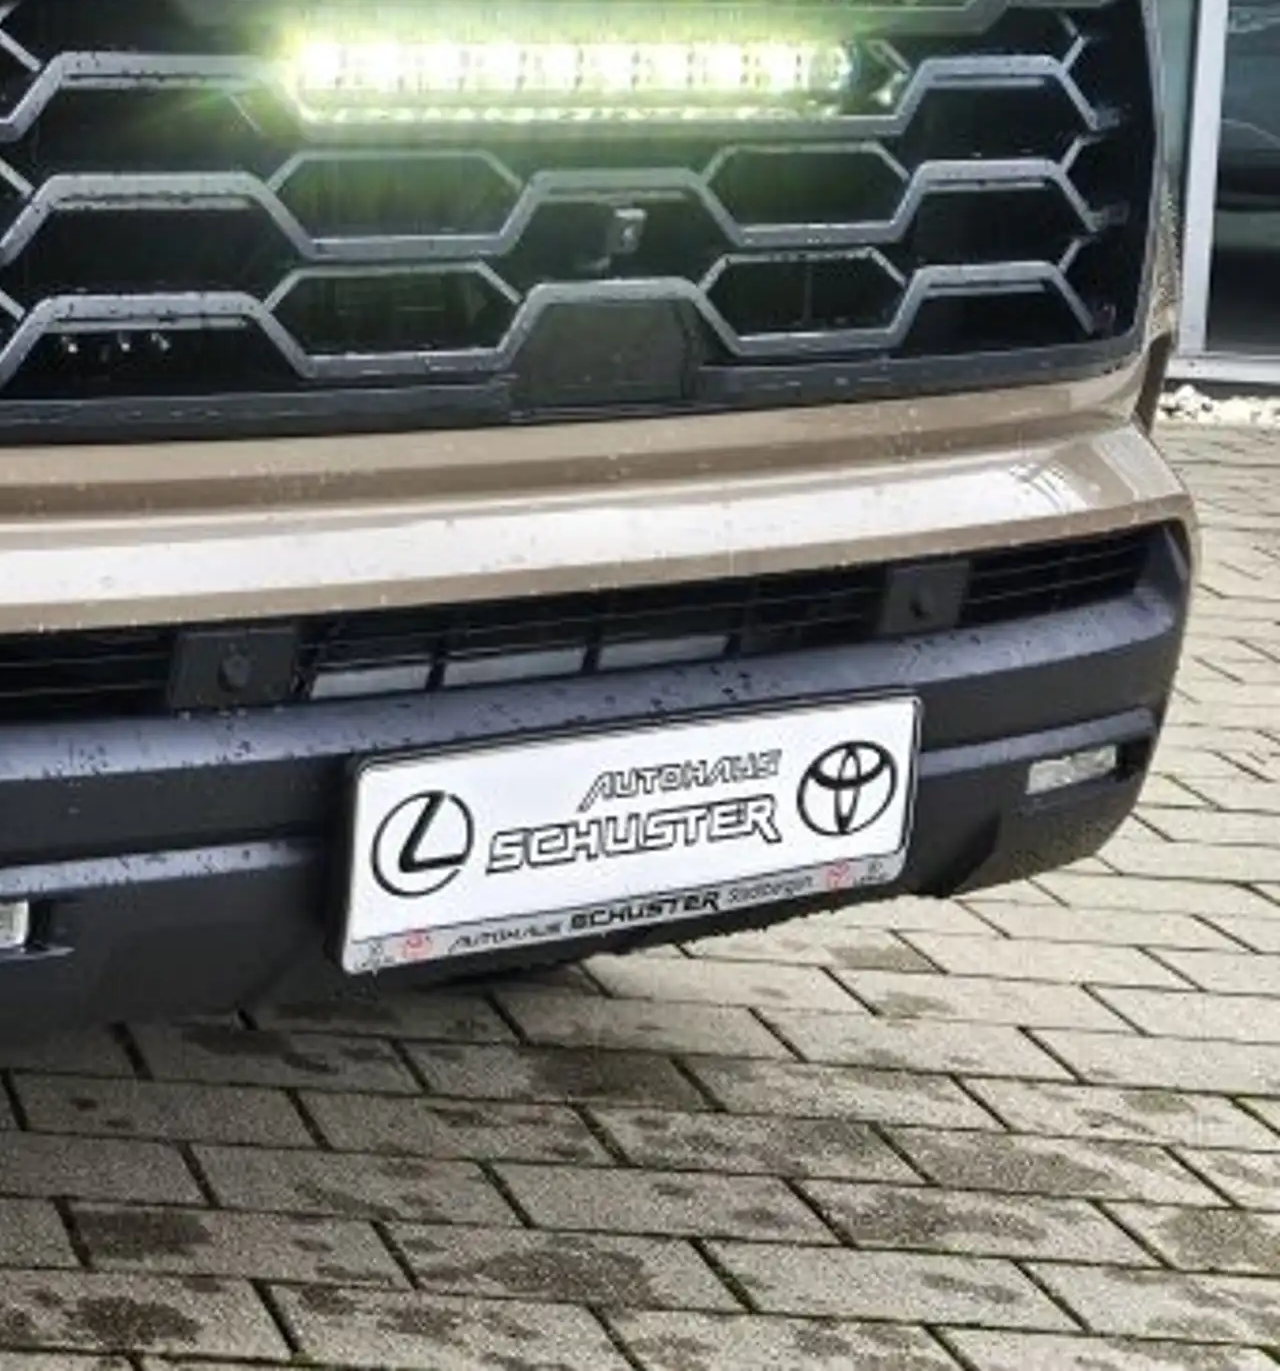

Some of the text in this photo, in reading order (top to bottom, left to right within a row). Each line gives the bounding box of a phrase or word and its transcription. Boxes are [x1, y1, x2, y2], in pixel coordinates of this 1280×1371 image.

[576, 748, 783, 813] AUTOHAUS
[485, 793, 783, 875] SCHUSTER
[447, 923, 563, 954] AUTOHAUS
[569, 891, 721, 929] SCHUSTER
